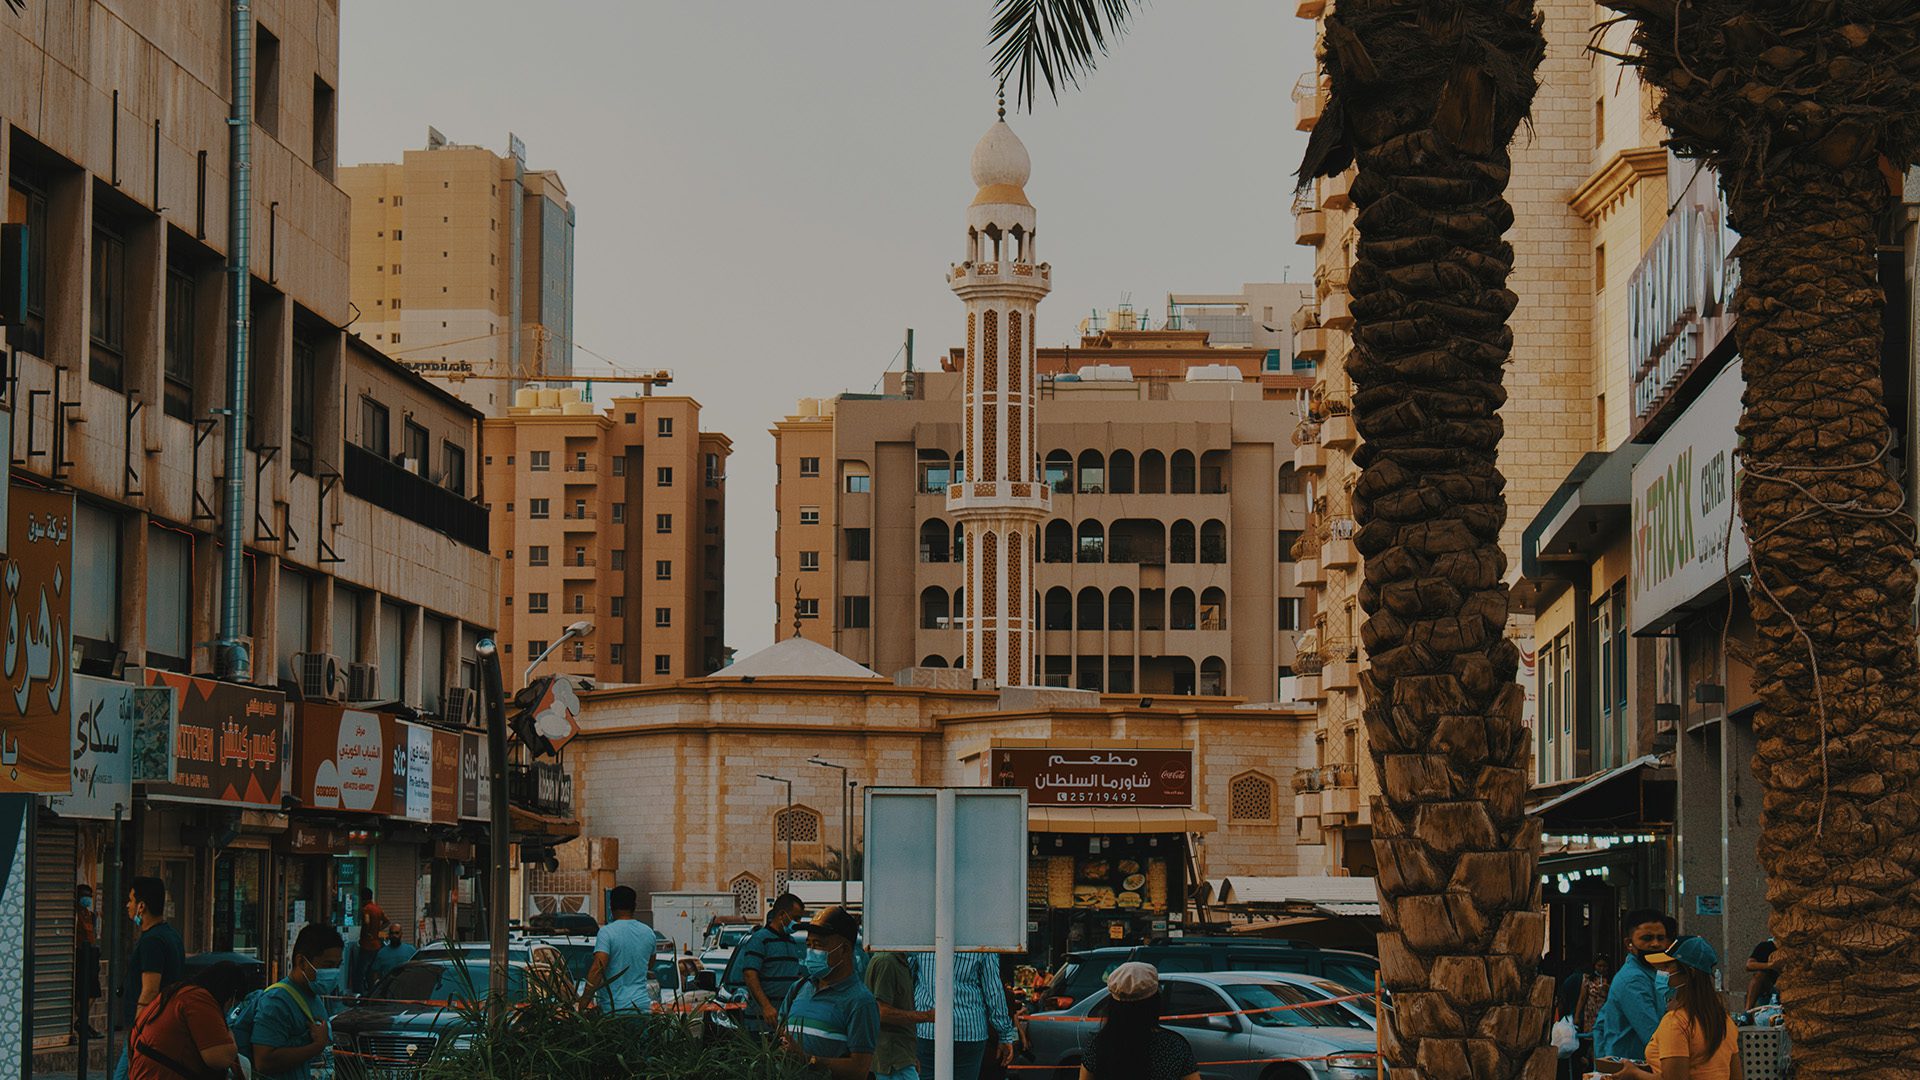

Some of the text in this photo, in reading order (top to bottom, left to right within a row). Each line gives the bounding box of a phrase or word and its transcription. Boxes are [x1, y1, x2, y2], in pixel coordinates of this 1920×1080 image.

[1701, 449, 1726, 518] CENTER
[27, 512, 67, 546] شركة سوق
[4, 558, 64, 717] زهرة
[73, 698, 120, 777] سكاي
[393, 744, 406, 776] stc
[464, 747, 477, 780] stc
[1048, 752, 1138, 767] مطعم
[1035, 771, 1151, 790] شاورما السلطان
[1070, 793, 1136, 802] 25719492
